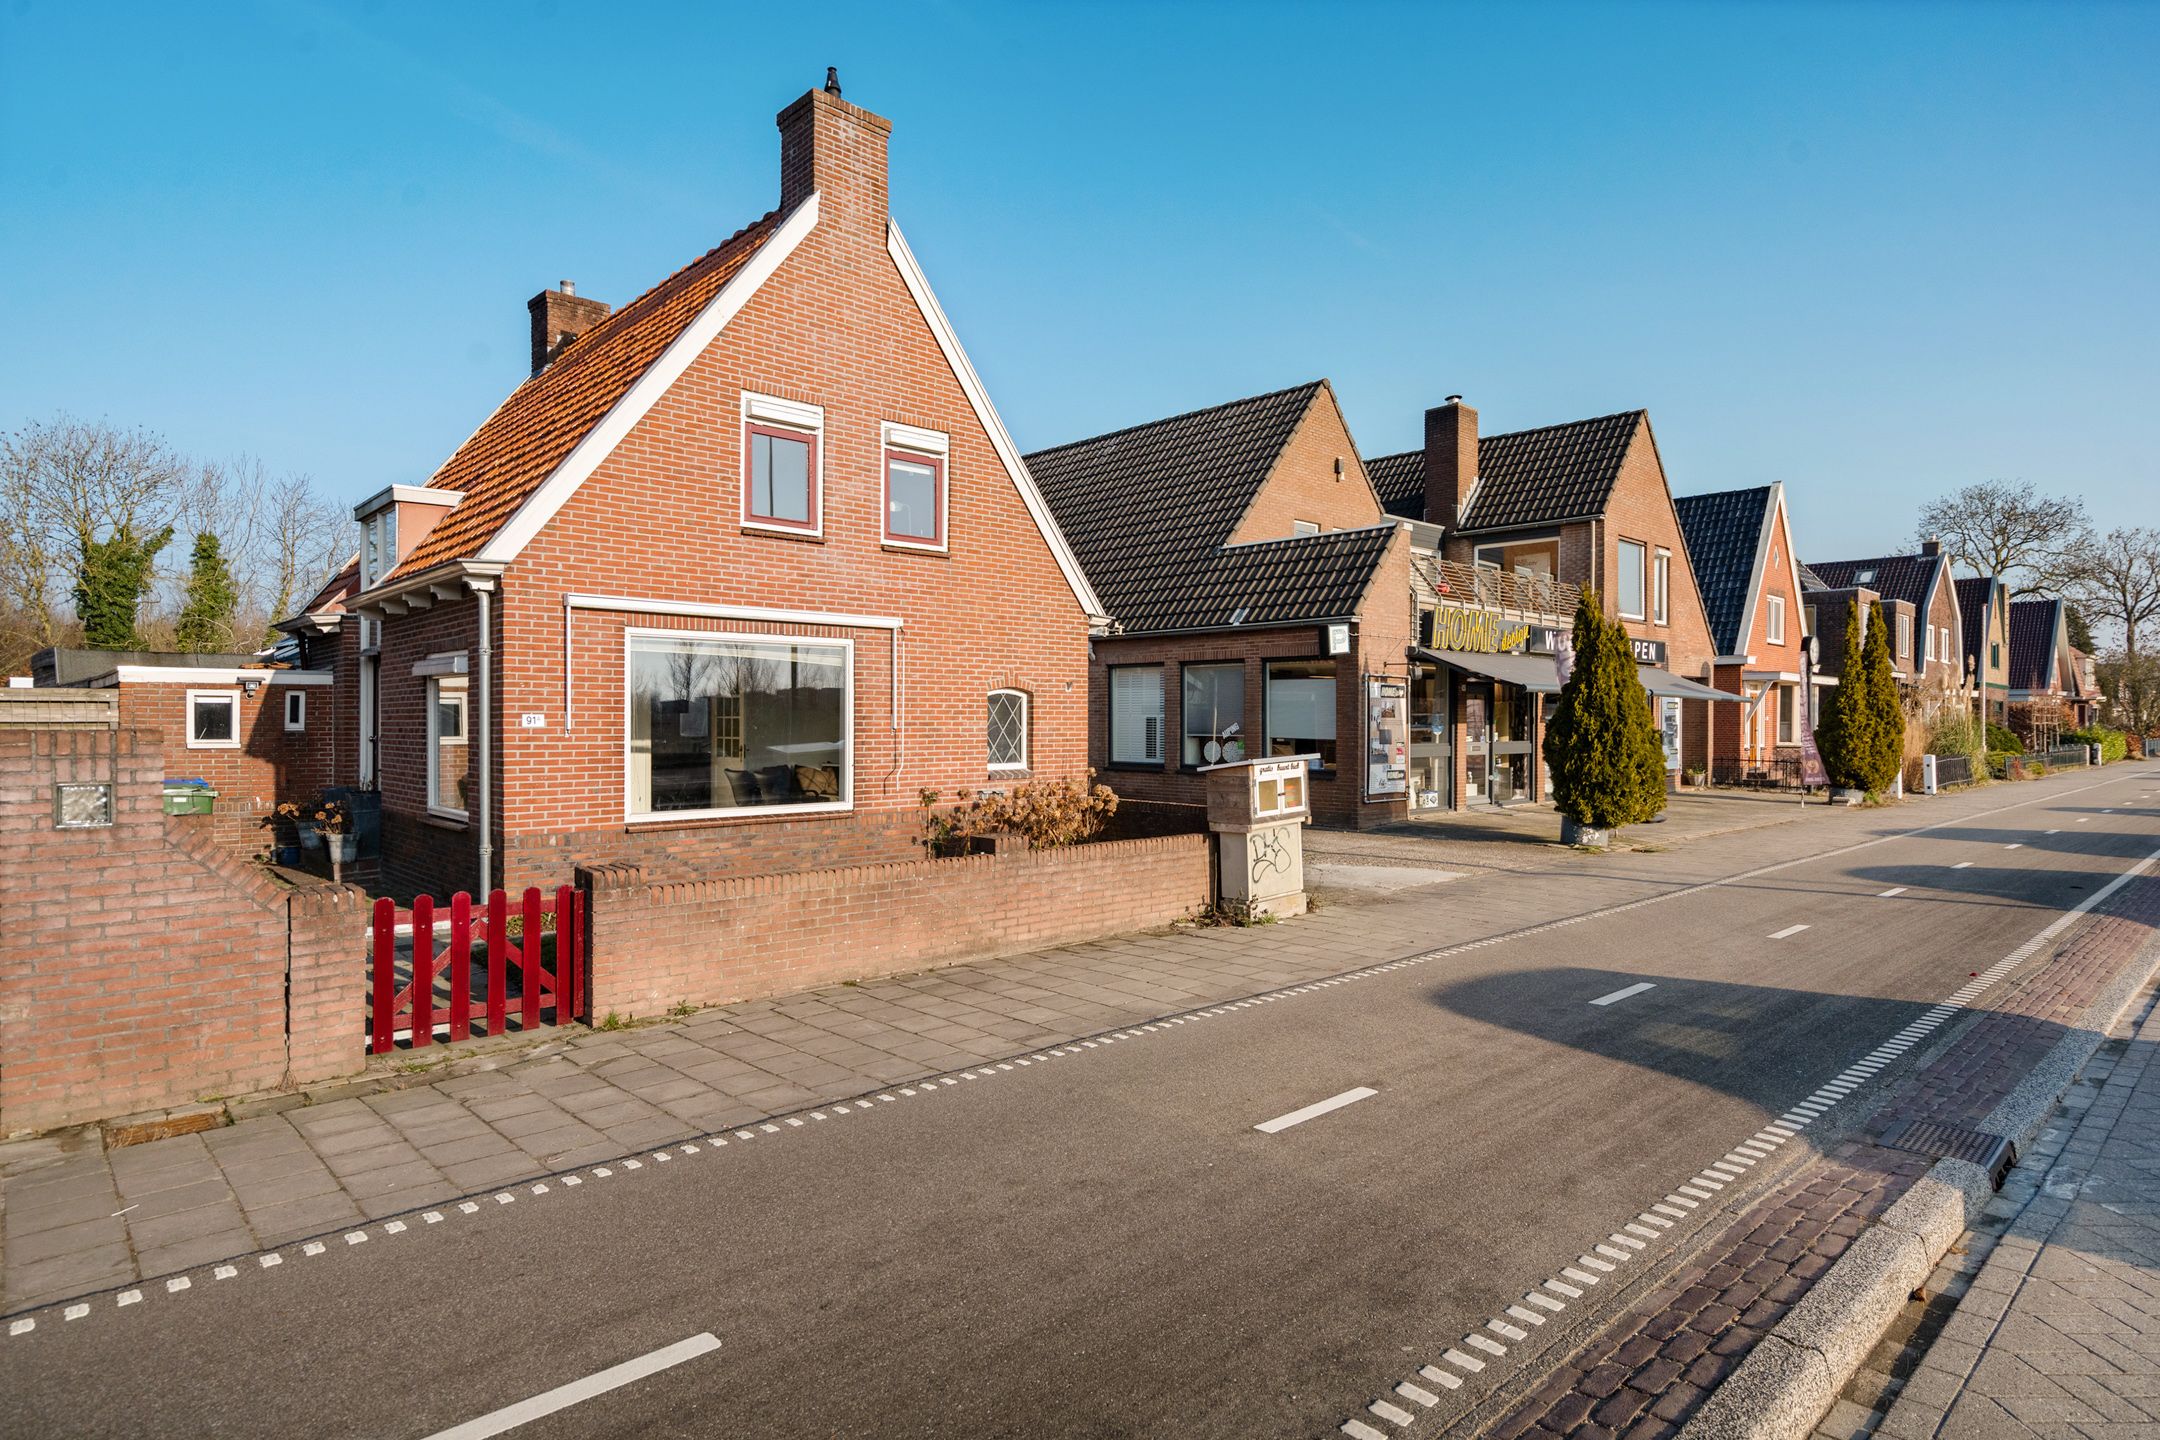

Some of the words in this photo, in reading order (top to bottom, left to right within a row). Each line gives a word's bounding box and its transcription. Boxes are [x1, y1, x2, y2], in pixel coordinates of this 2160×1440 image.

[1332, 629, 1347, 651] P
[1432, 606, 1501, 653] HOME
[1501, 624, 1530, 651] design
